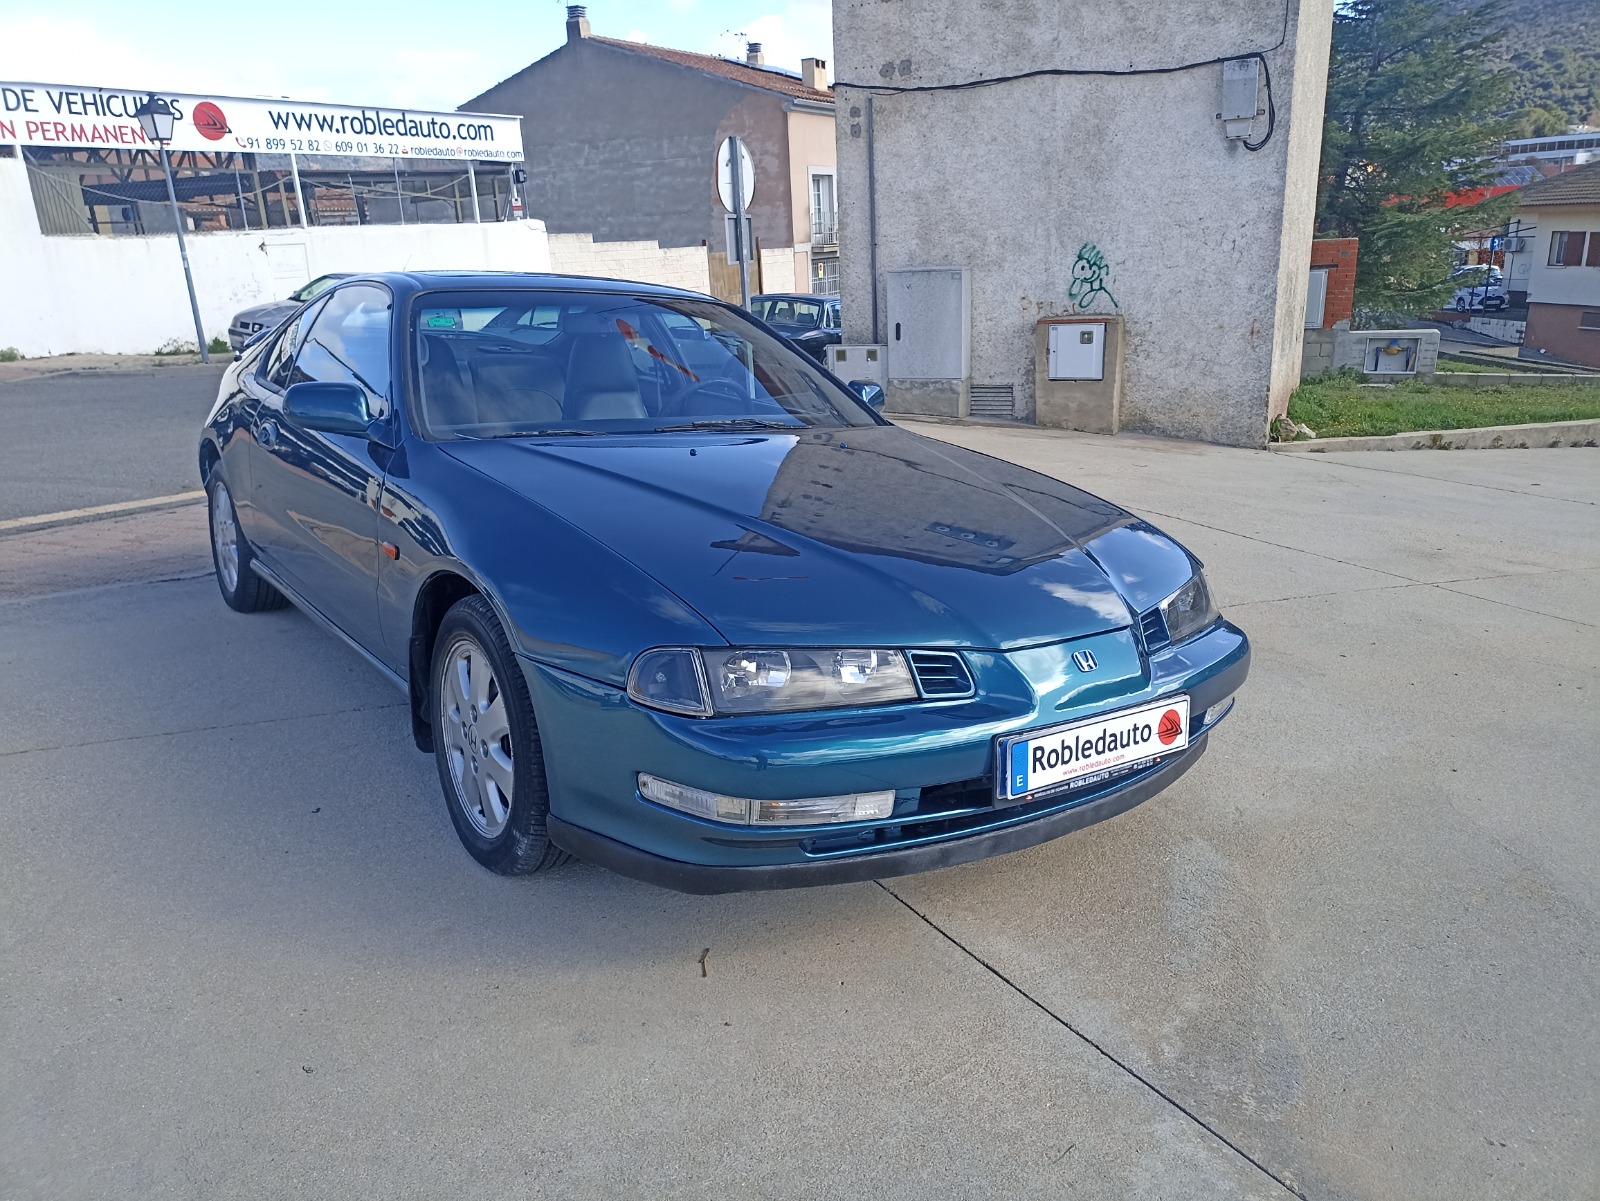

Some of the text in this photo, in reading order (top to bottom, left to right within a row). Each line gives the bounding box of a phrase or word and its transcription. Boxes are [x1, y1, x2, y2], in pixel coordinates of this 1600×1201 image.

[1, 87, 183, 120] DE VEHÍCUS
[25, 121, 171, 147] PERMANEN
[268, 110, 494, 142] www.robledauto.com
[246, 137, 260, 149] 91
[265, 138, 286, 150] 899
[290, 139, 304, 151] 52
[307, 139, 322, 152] 82
[335, 141, 353, 153] 609
[356, 142, 368, 153] 01
[373, 142, 385, 154] 36
[388, 143, 400, 155] 22
[1032, 723, 1152, 773] Robledauto
[1062, 753, 1126, 777] www.robledauto.com
[1016, 774, 1024, 787] E
[1069, 770, 1110, 789] ROBLEDAUTO
